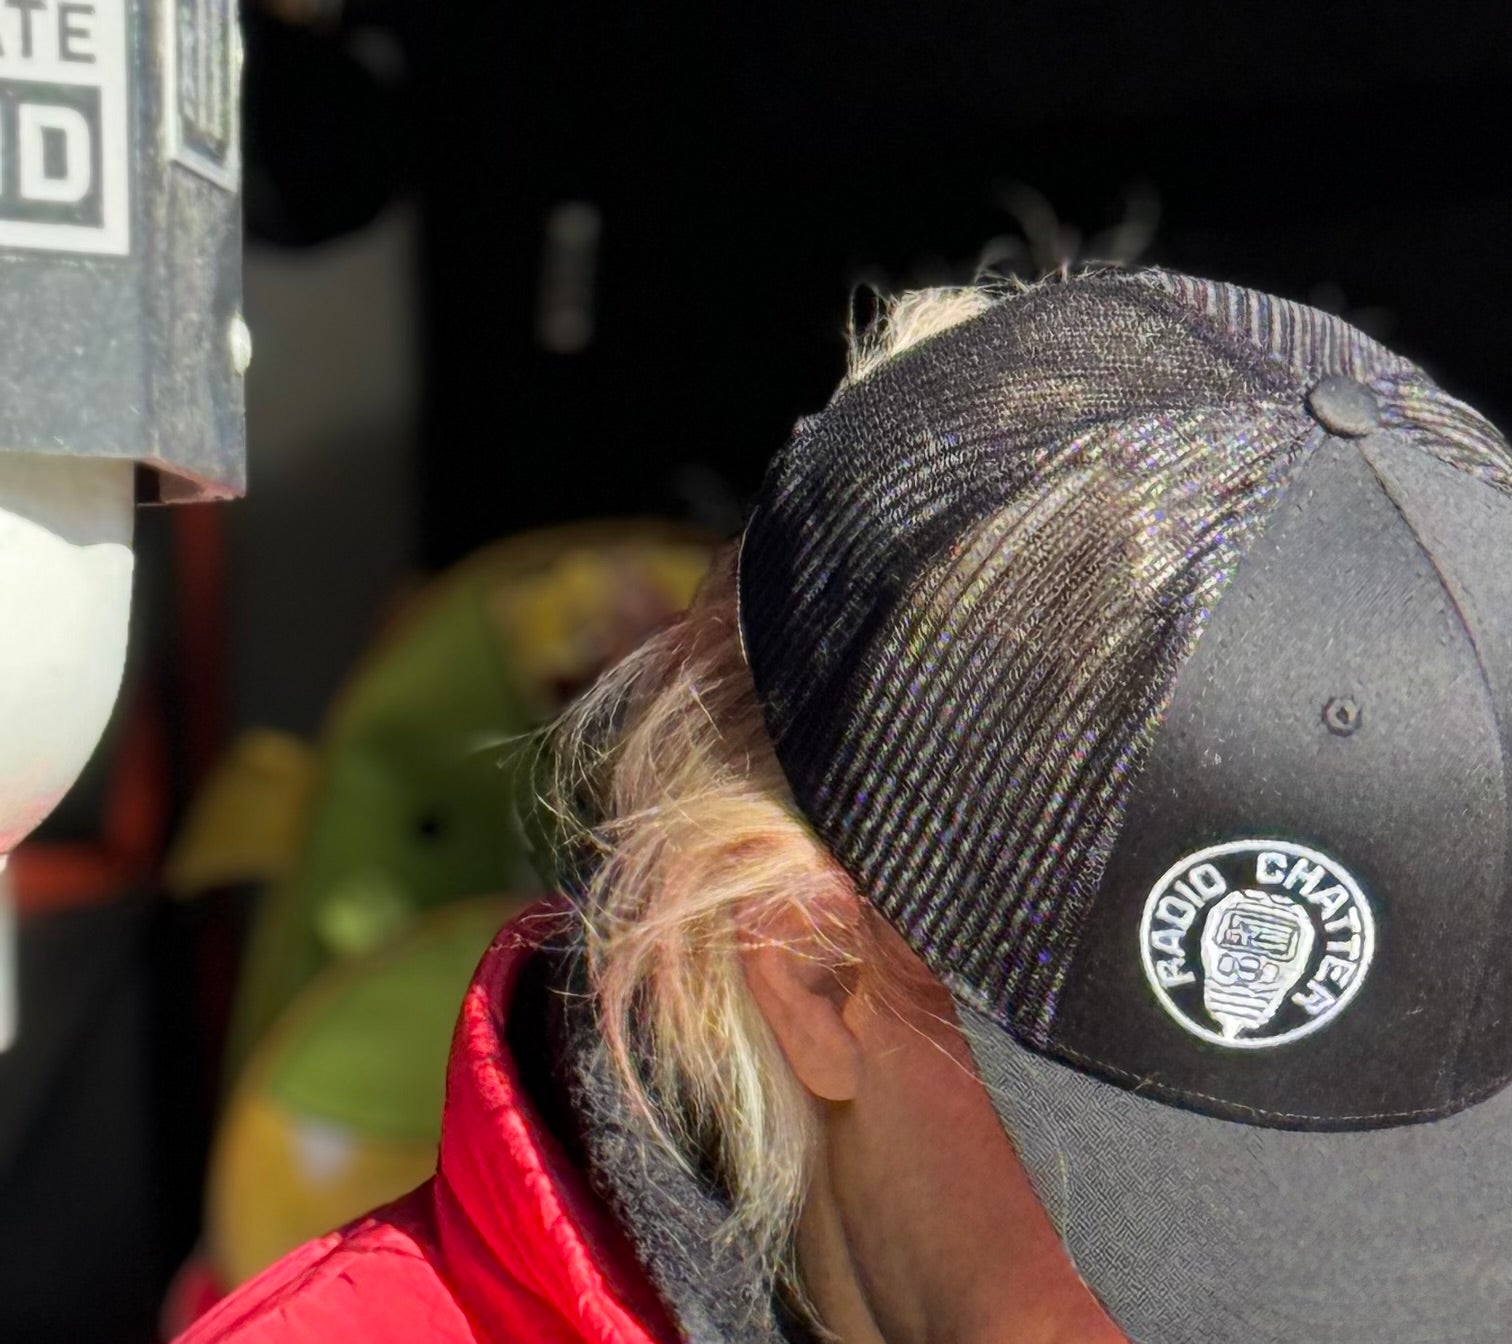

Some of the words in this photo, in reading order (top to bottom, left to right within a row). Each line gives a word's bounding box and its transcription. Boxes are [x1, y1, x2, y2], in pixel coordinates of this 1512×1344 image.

[0, 0, 96, 64] TE
[0, 103, 91, 202] D
[1151, 863, 1227, 988] RADIO
[1256, 852, 1362, 1015] CHATTER
